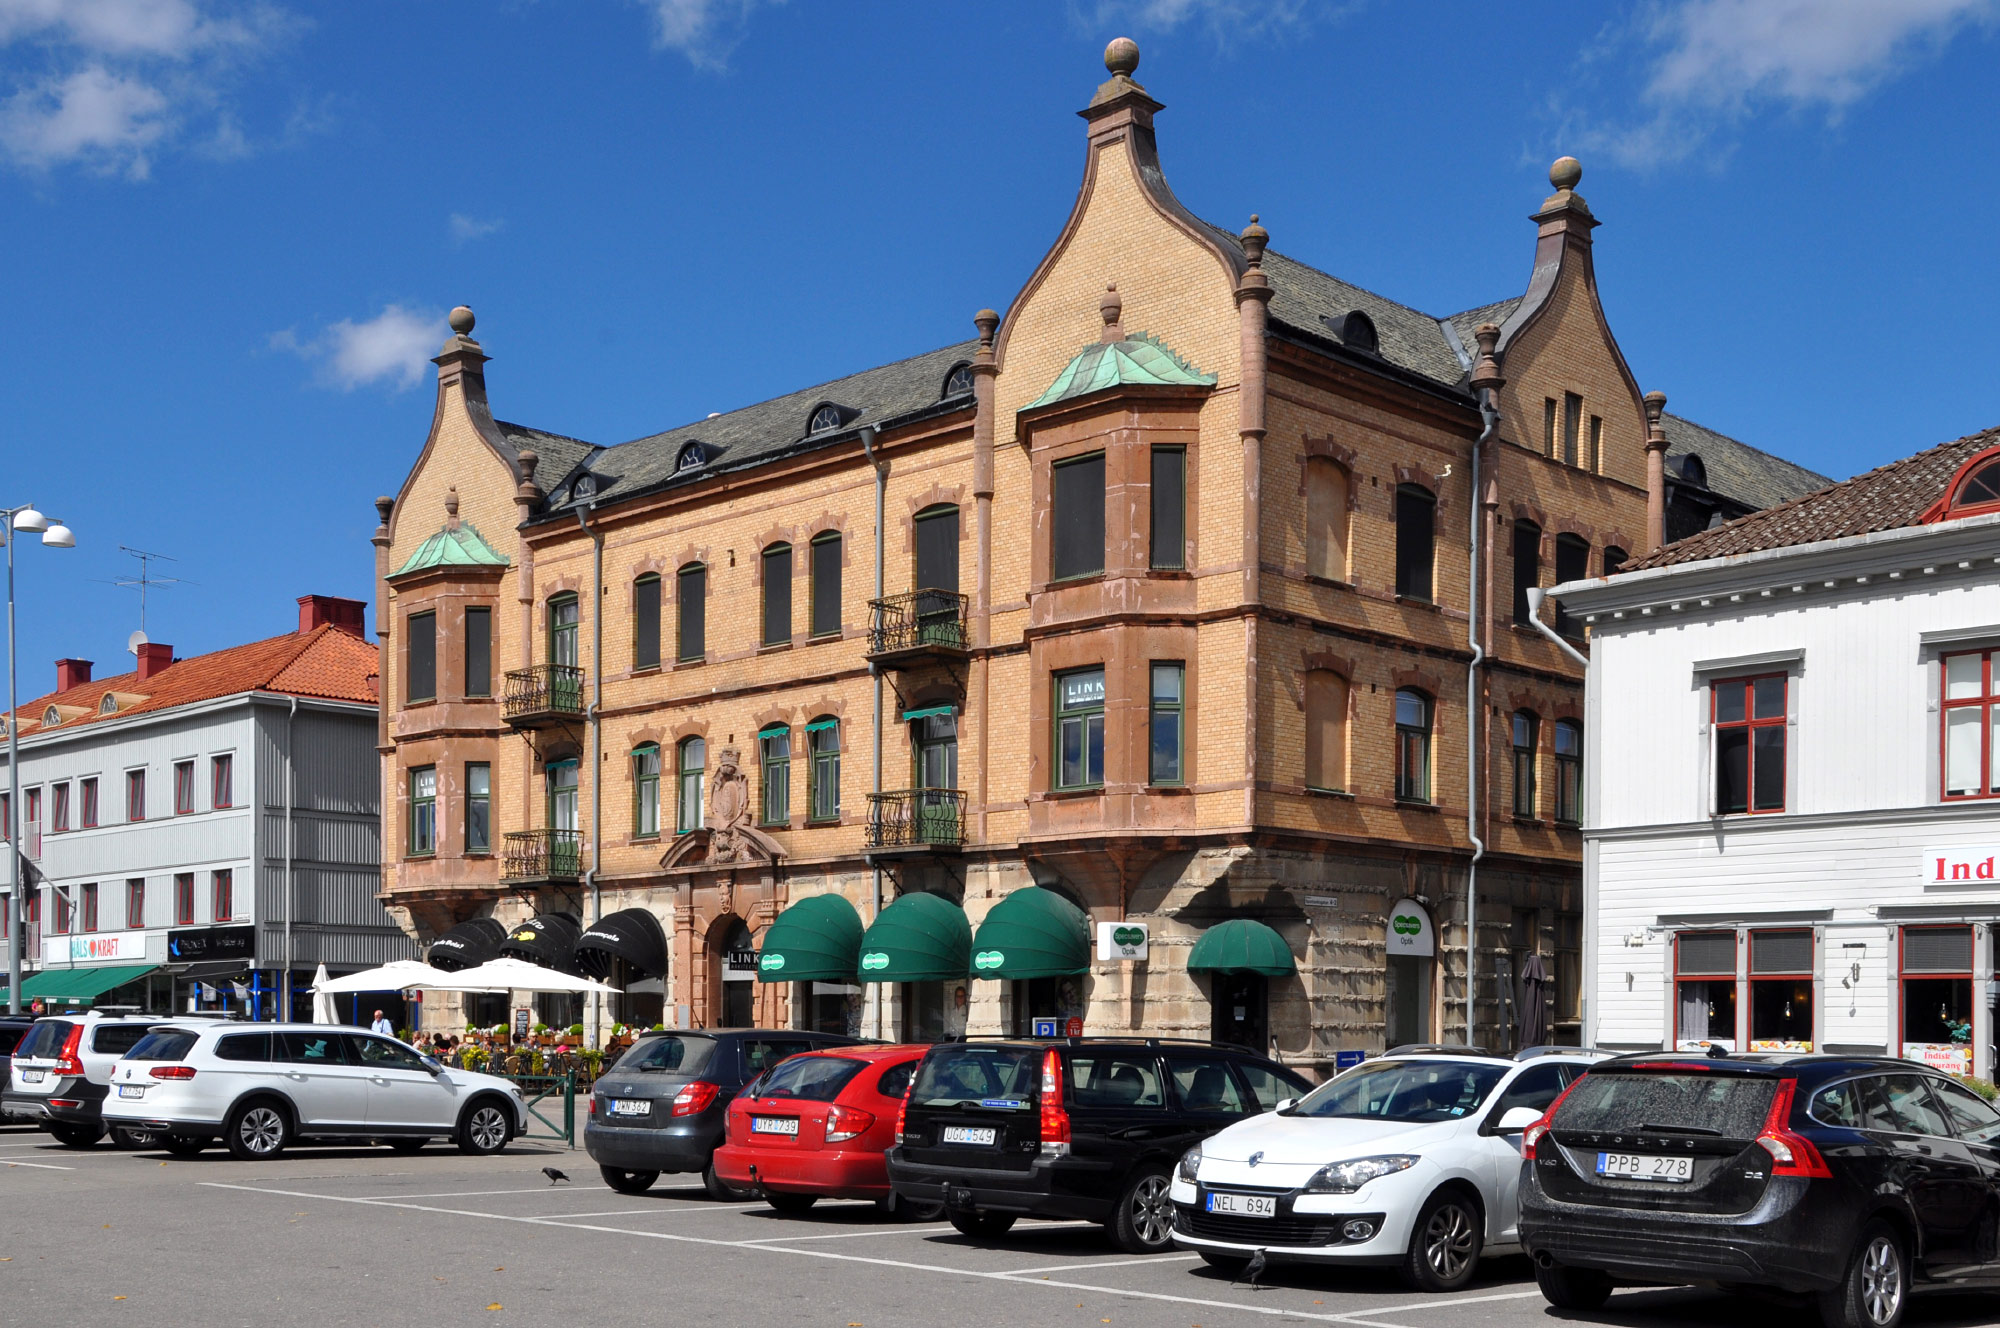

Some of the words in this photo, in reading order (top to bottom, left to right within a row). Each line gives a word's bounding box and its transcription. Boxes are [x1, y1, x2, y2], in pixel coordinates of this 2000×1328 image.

[1068, 682, 1104, 696] LINK
[1936, 857, 1995, 881] Ind
[1394, 920, 1420, 929] Specsavers
[1115, 932, 1144, 940] Specsavers
[1400, 937, 1414, 945] Optik
[97, 938, 119, 958] KRAFT
[1122, 947, 1137, 956] Optik
[730, 953, 759, 964] LINK
[1041, 1024, 1050, 1036] P
[1924, 1051, 1951, 1060] Indisk
[756, 1117, 773, 1130] UYR
[779, 1119, 796, 1132] 739
[946, 1127, 965, 1141] UGC
[972, 1129, 993, 1142] 549
[1607, 1155, 1640, 1173] PPB
[1653, 1158, 1688, 1176] 278
[1214, 1195, 1237, 1211] NEL
[1246, 1198, 1272, 1214] 694
